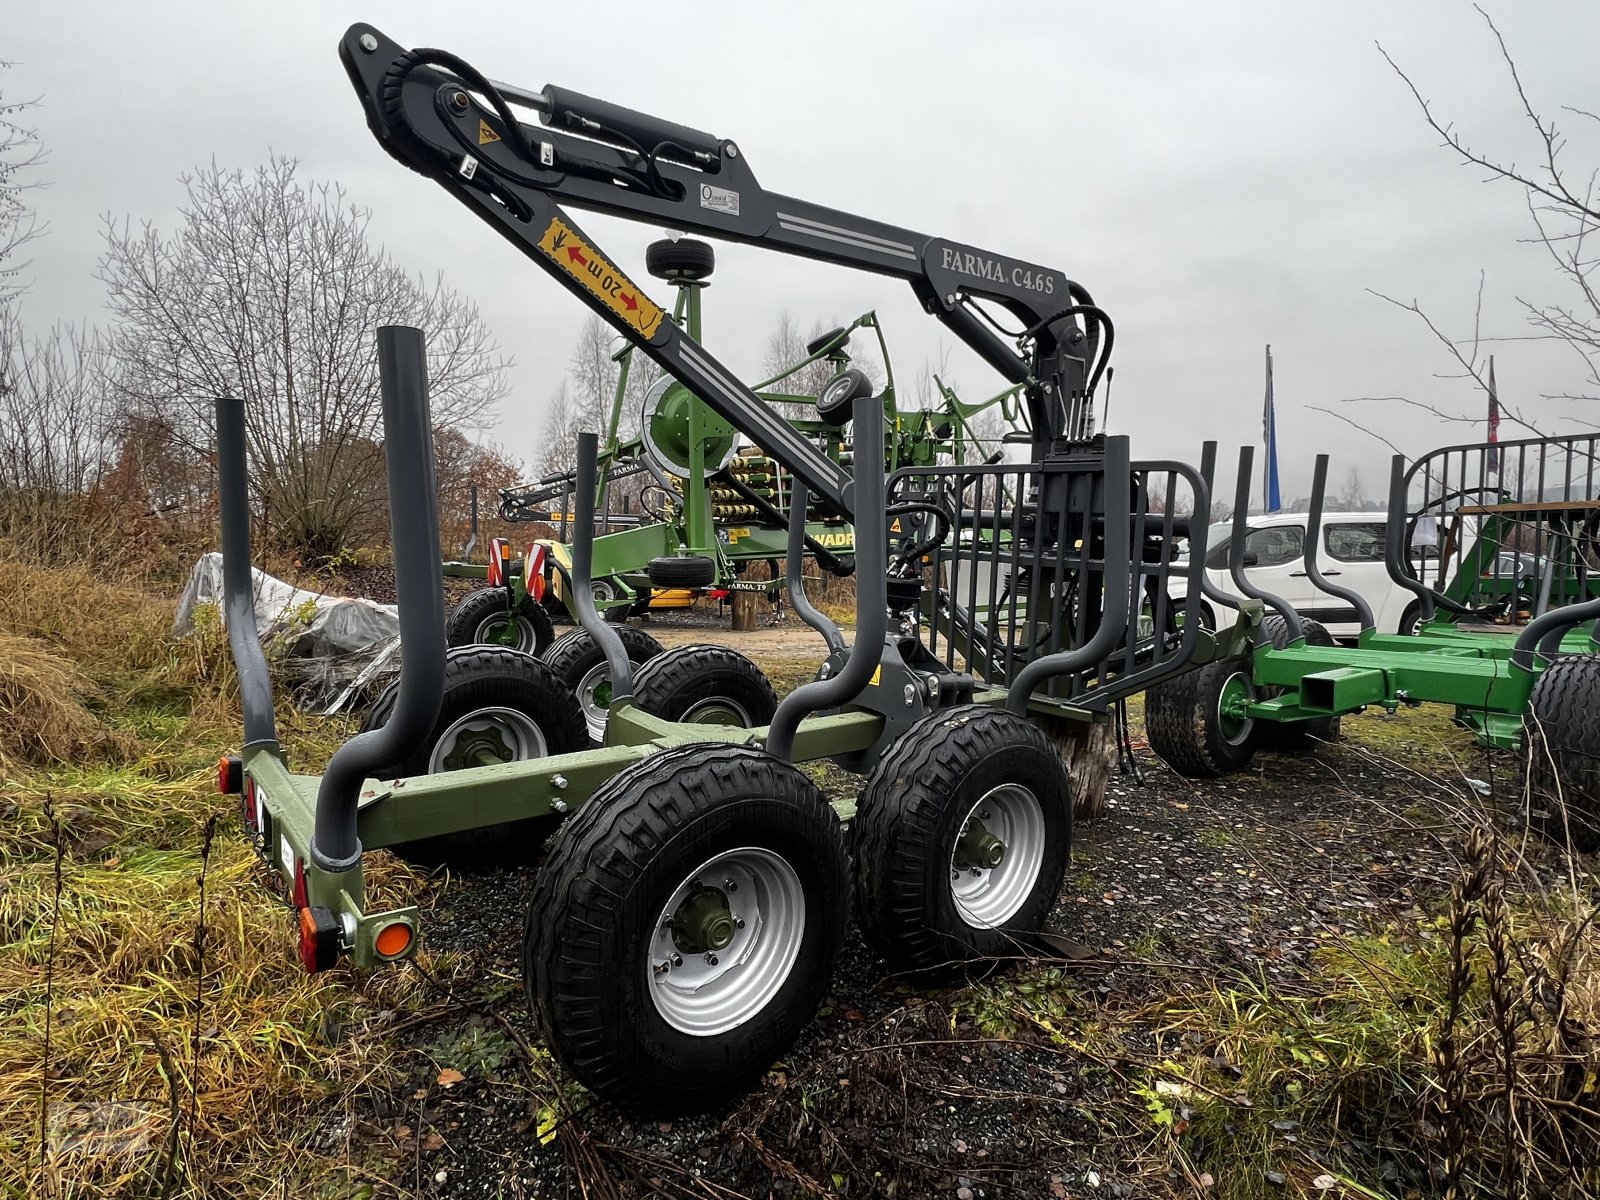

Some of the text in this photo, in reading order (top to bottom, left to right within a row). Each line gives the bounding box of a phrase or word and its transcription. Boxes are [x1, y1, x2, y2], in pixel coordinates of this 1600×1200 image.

[587, 260, 622, 298] 20 m
[941, 247, 1054, 294] FARMA C4.6S
[613, 463, 640, 476] FARMA
[810, 533, 854, 546] WADR
